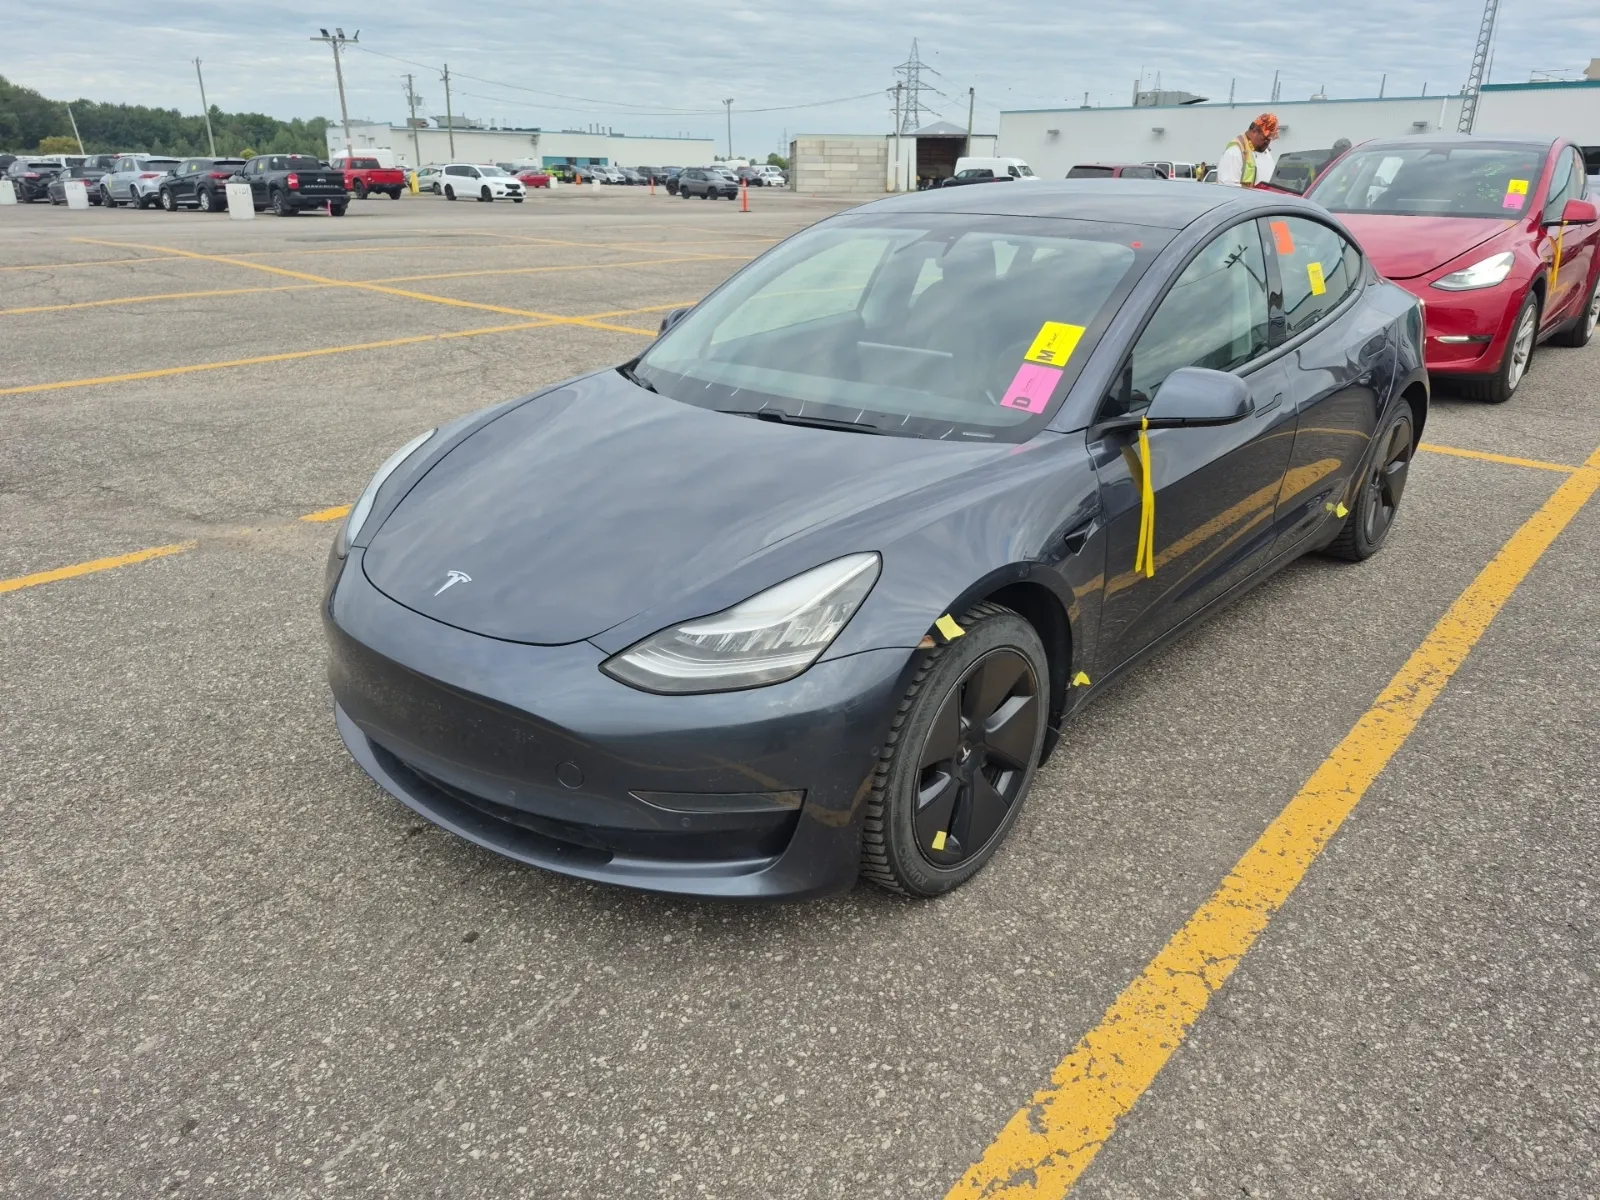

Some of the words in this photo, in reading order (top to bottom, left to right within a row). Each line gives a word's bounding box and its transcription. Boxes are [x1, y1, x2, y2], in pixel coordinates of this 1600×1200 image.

[1036, 349, 1057, 361] M
[1012, 396, 1032, 408] D
[898, 845, 929, 888] KUMHO
